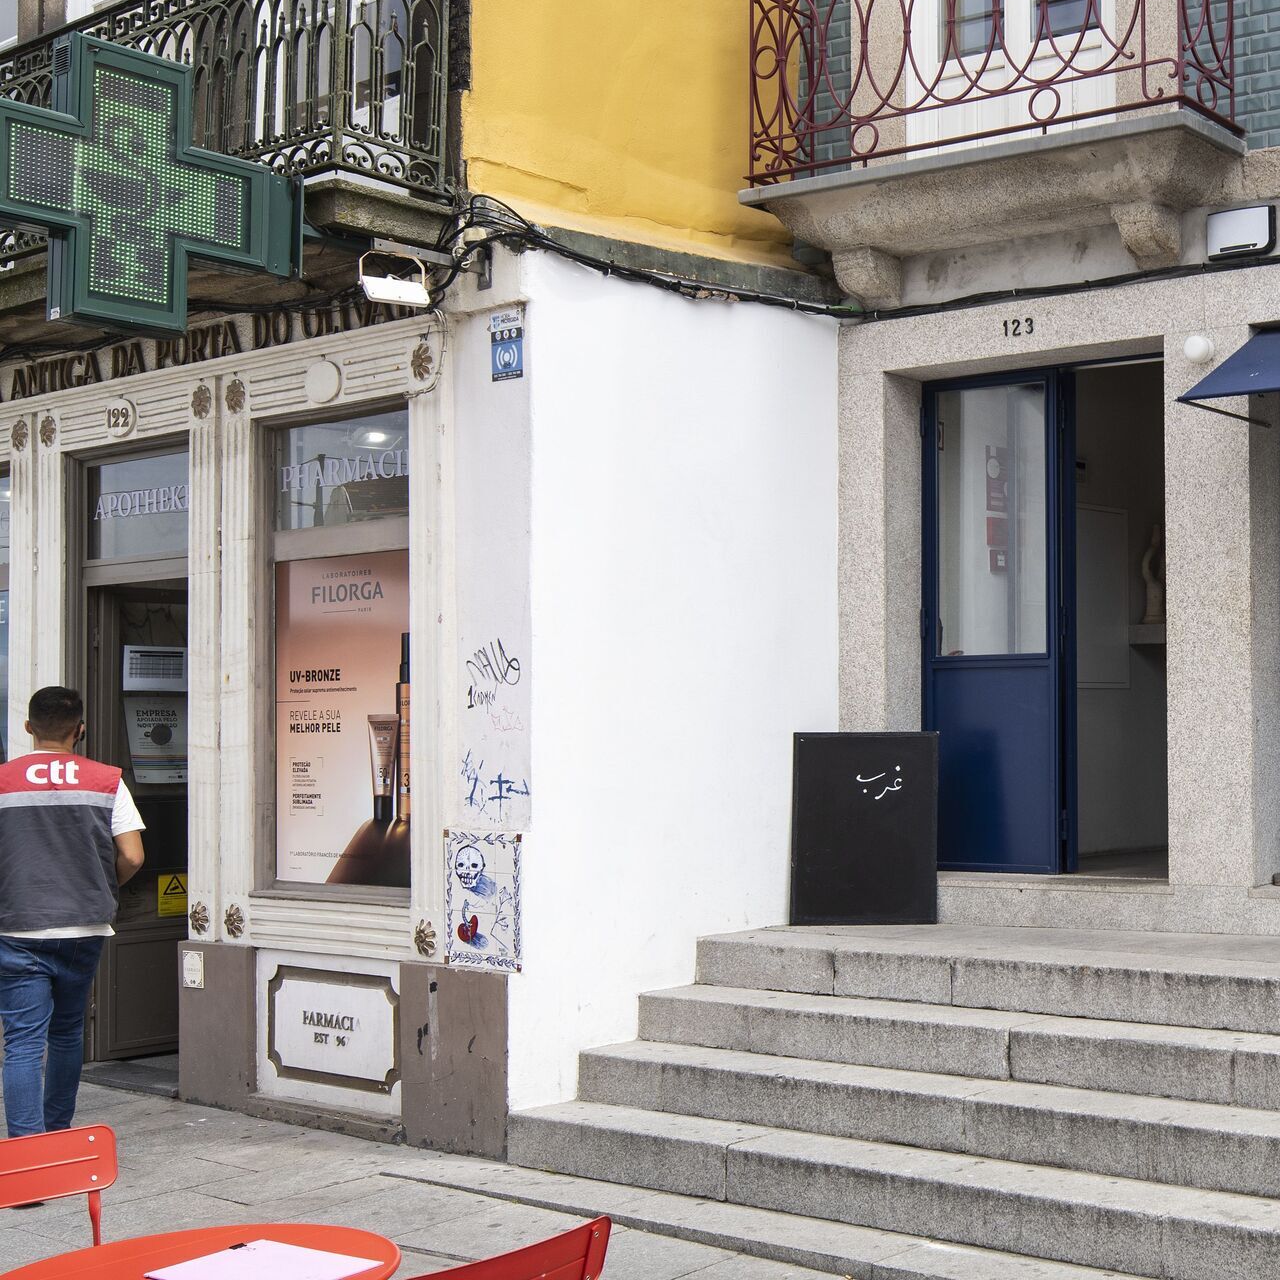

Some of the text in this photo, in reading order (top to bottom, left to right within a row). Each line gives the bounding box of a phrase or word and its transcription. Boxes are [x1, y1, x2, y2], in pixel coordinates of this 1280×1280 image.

[1003, 317, 1034, 337] 123
[10, 349, 103, 401] ANTIGA
[110, 342, 146, 379] DA
[154, 320, 242, 370] PORTA
[250, 310, 292, 349] DO
[106, 407, 130, 429] 122
[281, 449, 409, 492] PHARMACI
[322, 569, 372, 580] LABORATOIRES
[311, 581, 384, 604] FILORGA
[289, 668, 341, 683] UV-BRONZE
[136, 709, 177, 717] EMPRESA
[289, 709, 341, 721] REVELE A SUA
[289, 722, 341, 733] MELHOR PELE
[25, 759, 80, 785] ctt
[313, 1032, 330, 1044] EST
